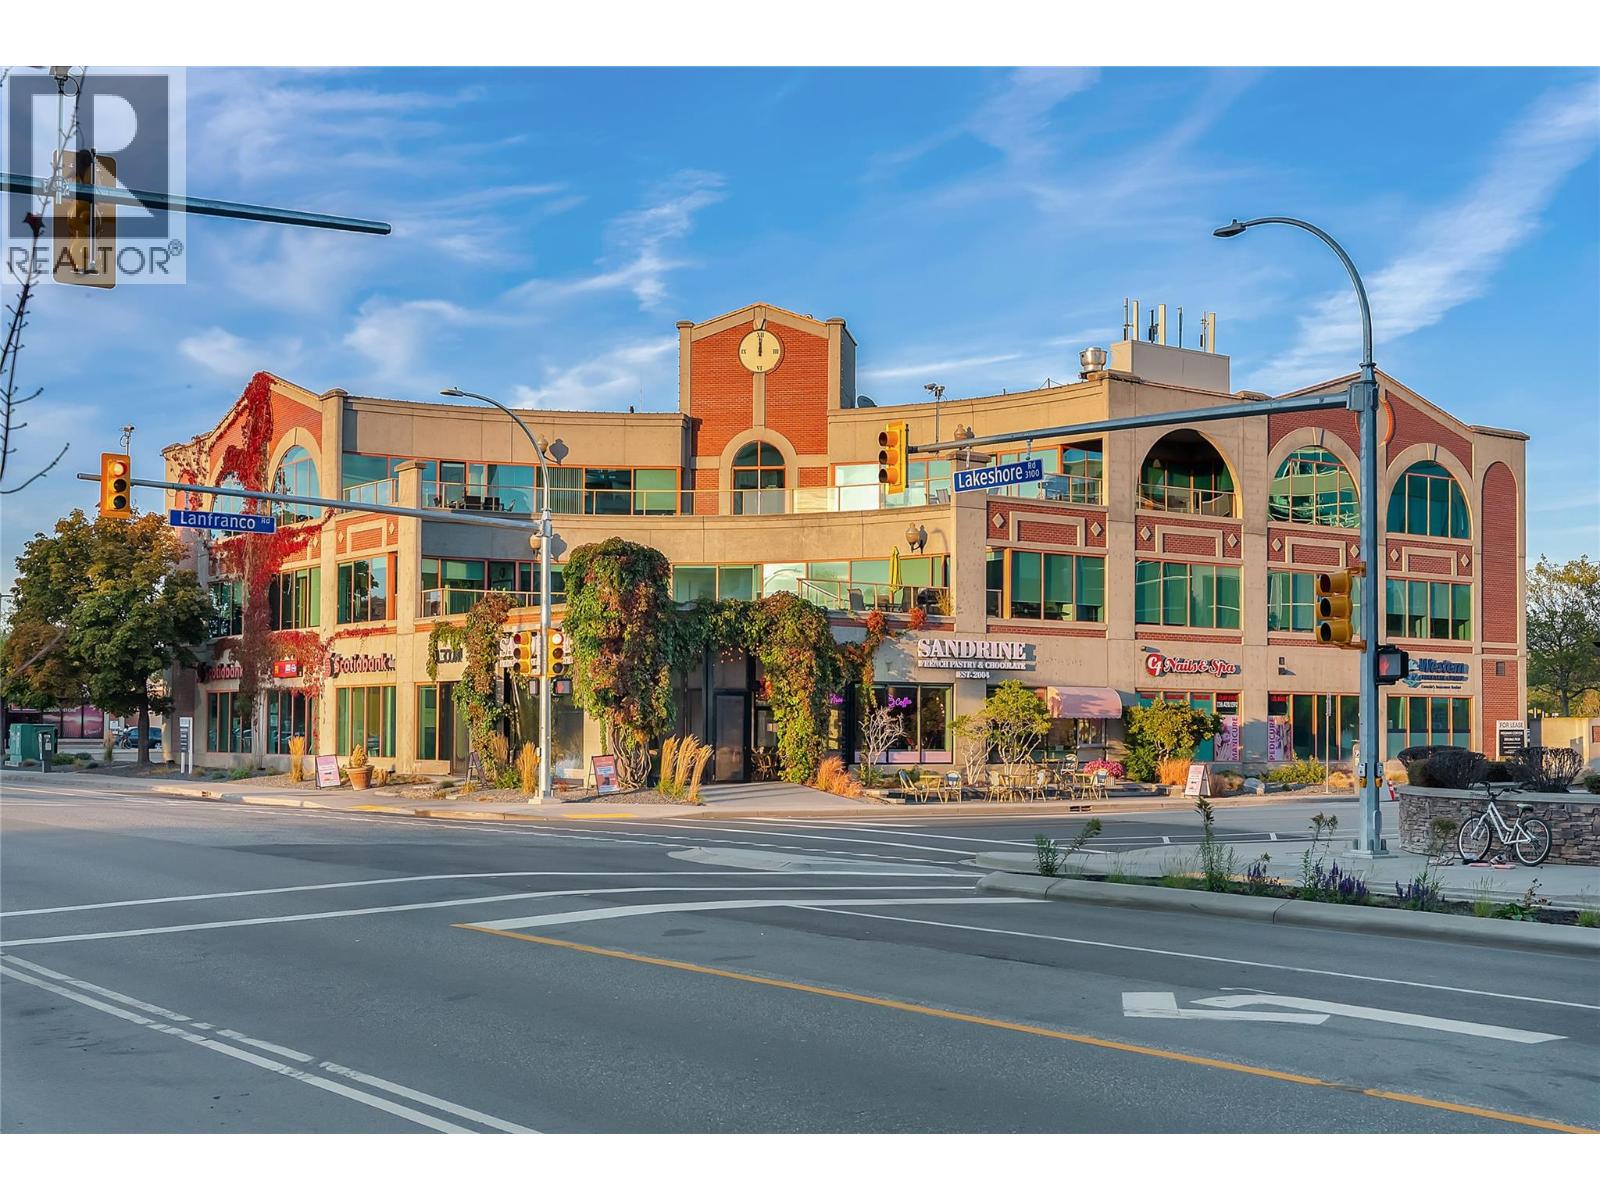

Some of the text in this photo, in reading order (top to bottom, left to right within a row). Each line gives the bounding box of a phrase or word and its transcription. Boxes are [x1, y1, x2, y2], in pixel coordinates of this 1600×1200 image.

[958, 462, 1036, 488] Lakeshore Rd
[1025, 469, 1039, 479] 3100
[180, 511, 256, 529] Lanfranco
[917, 639, 1026, 660] SANDRINE
[208, 665, 243, 680] cotiabank
[335, 654, 387, 673] Scotiabank
[918, 659, 1026, 670] FRENCH PASTRY & CHOCOLATE
[1163, 657, 1198, 673] Nails
[1199, 660, 1208, 672] &
[1209, 659, 1235, 678] Spa
[1418, 658, 1465, 673] Western
